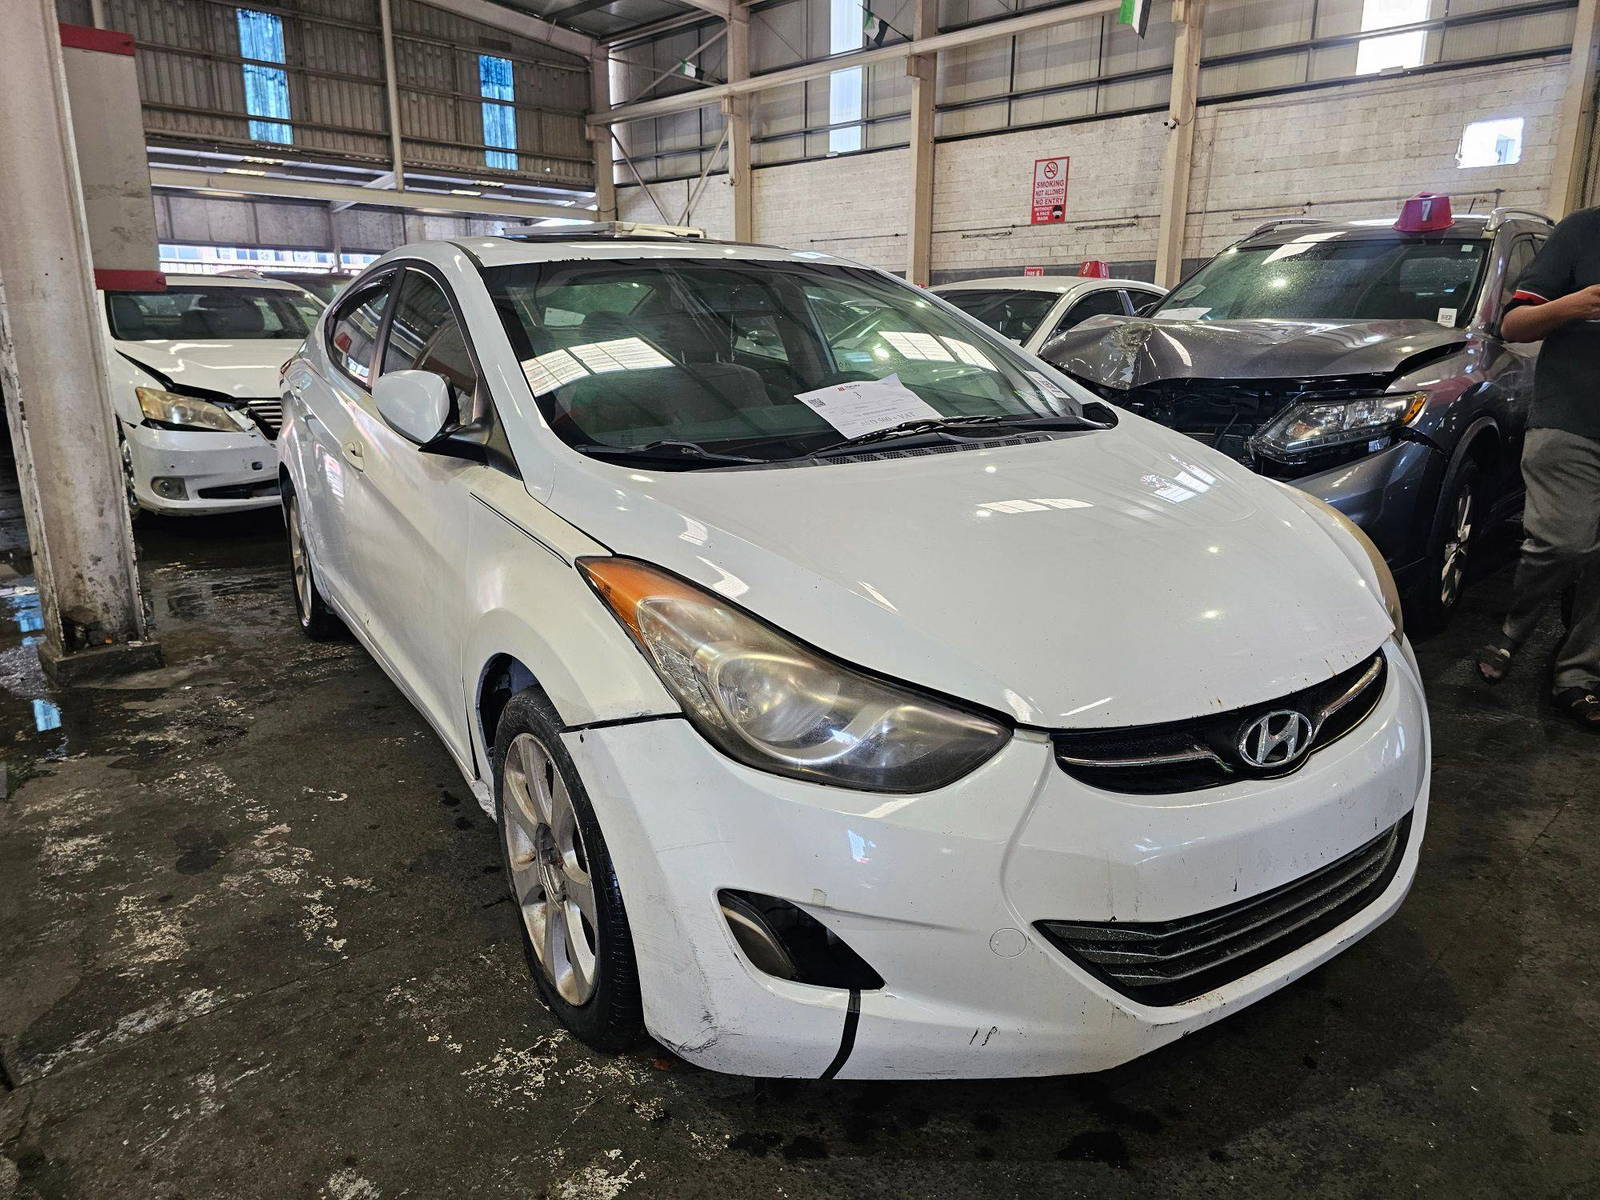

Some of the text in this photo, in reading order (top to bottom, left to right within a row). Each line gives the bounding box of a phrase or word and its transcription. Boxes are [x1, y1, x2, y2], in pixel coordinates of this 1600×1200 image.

[1036, 180, 1064, 188] SMOKING
[1045, 188, 1064, 196] ALLOWED
[1421, 200, 1432, 222] 7
